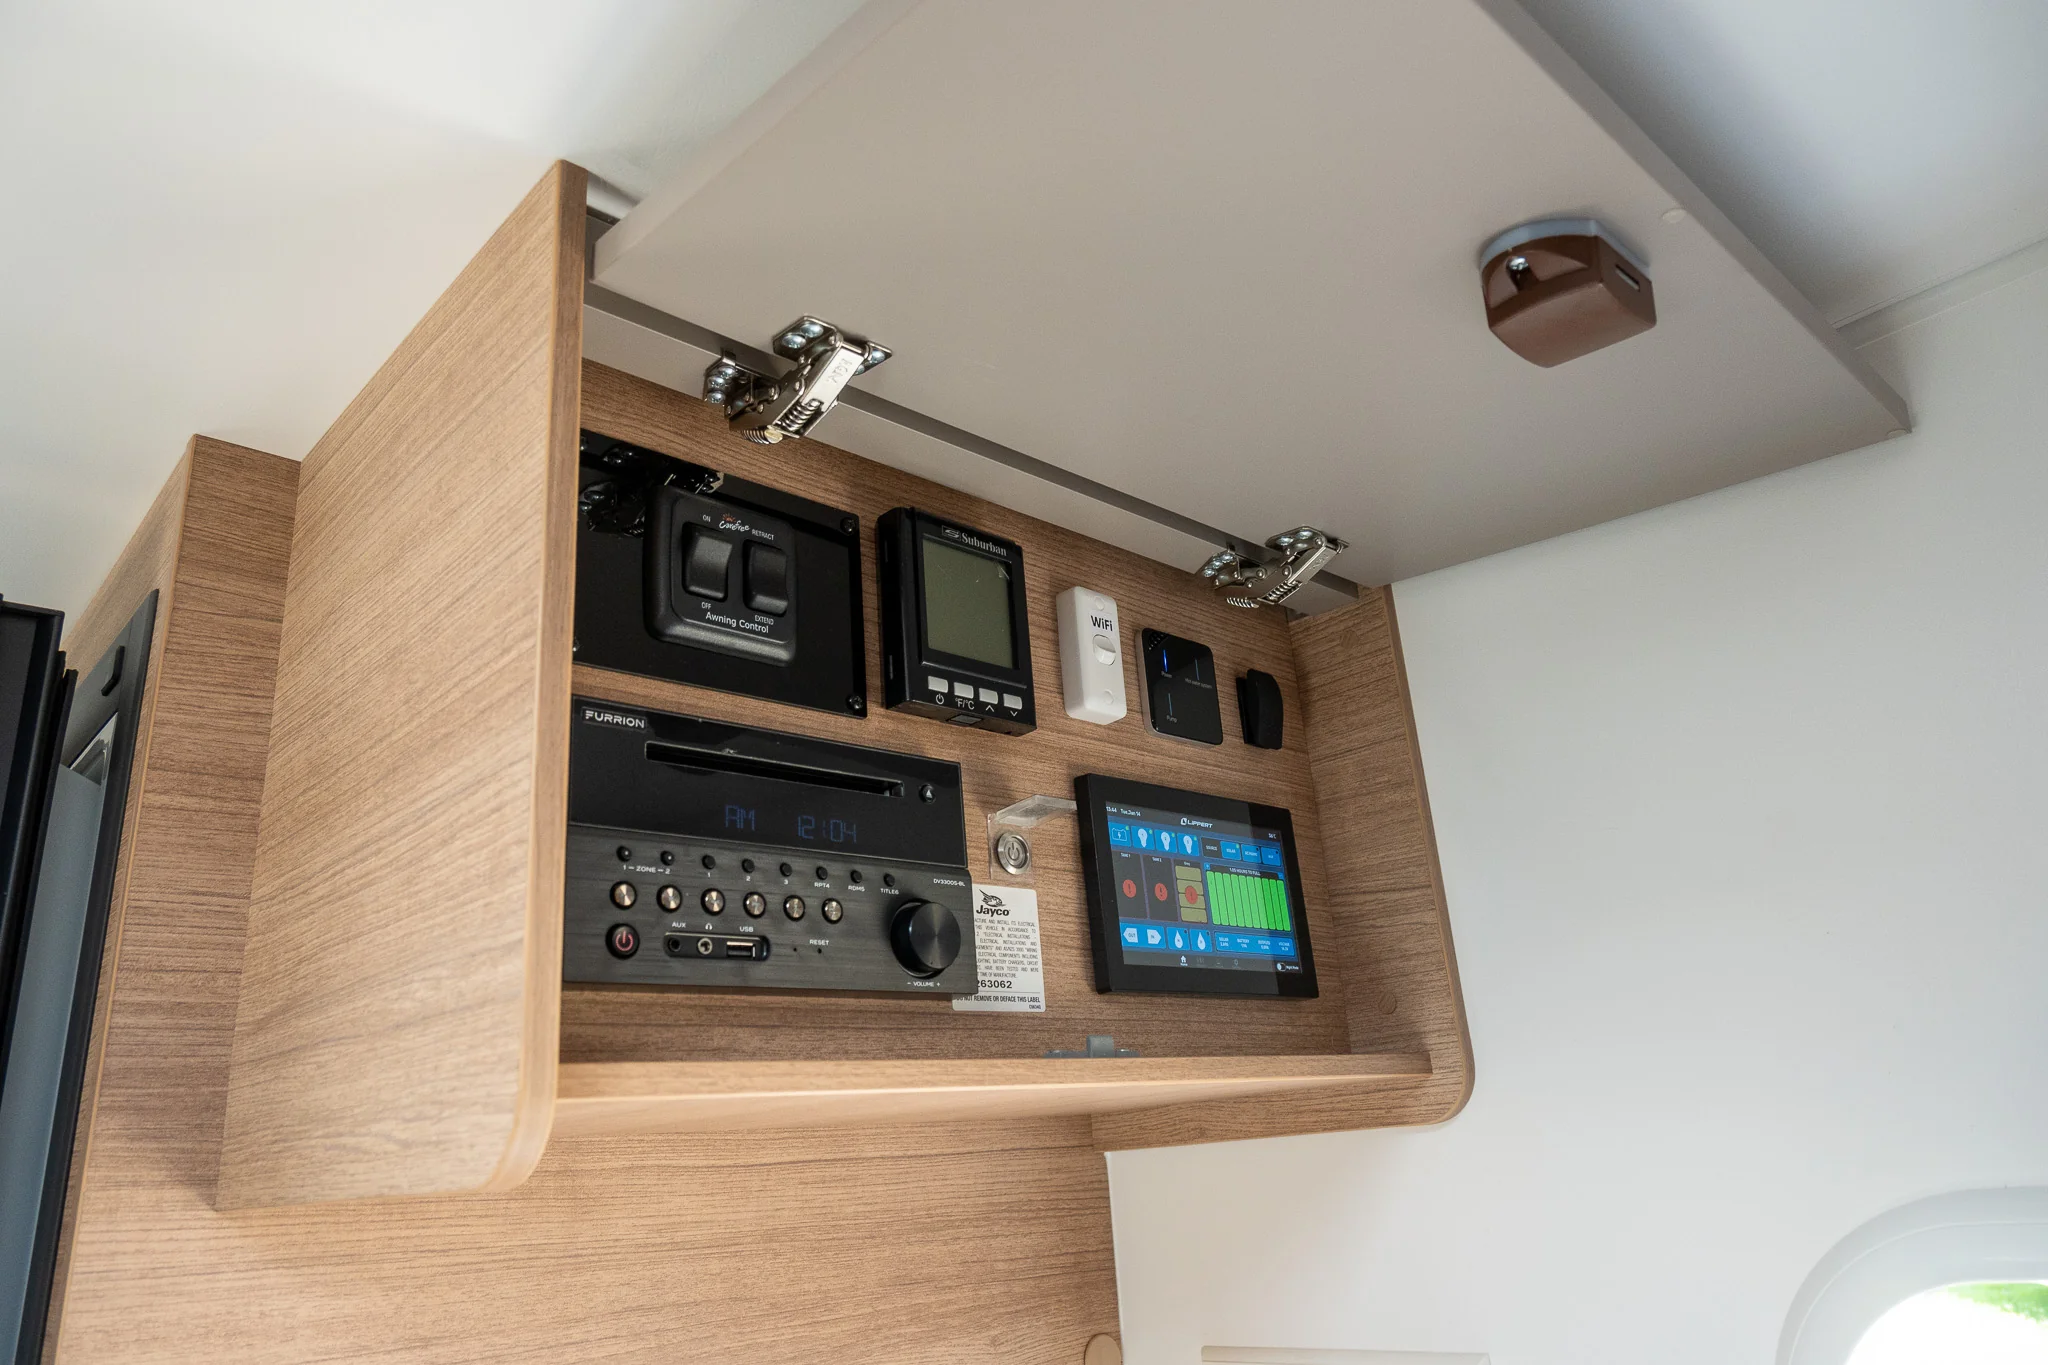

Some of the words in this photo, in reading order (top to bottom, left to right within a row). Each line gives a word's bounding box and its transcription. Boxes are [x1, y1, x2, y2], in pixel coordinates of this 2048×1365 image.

[702, 514, 711, 522] ON
[718, 520, 751, 532] Carefree
[751, 528, 775, 540] RETRACT
[961, 532, 1007, 556] Suburban
[701, 601, 712, 610] OFF
[705, 611, 737, 628] Awning
[739, 619, 769, 634] Control
[754, 614, 775, 626] EXTEND
[1090, 615, 1113, 631] WiFi
[585, 710, 645, 729] FURRION
[725, 804, 755, 832] AM
[797, 815, 857, 843] 12:04
[1187, 820, 1213, 828] LIPPERT
[976, 905, 1010, 917] Jayco
